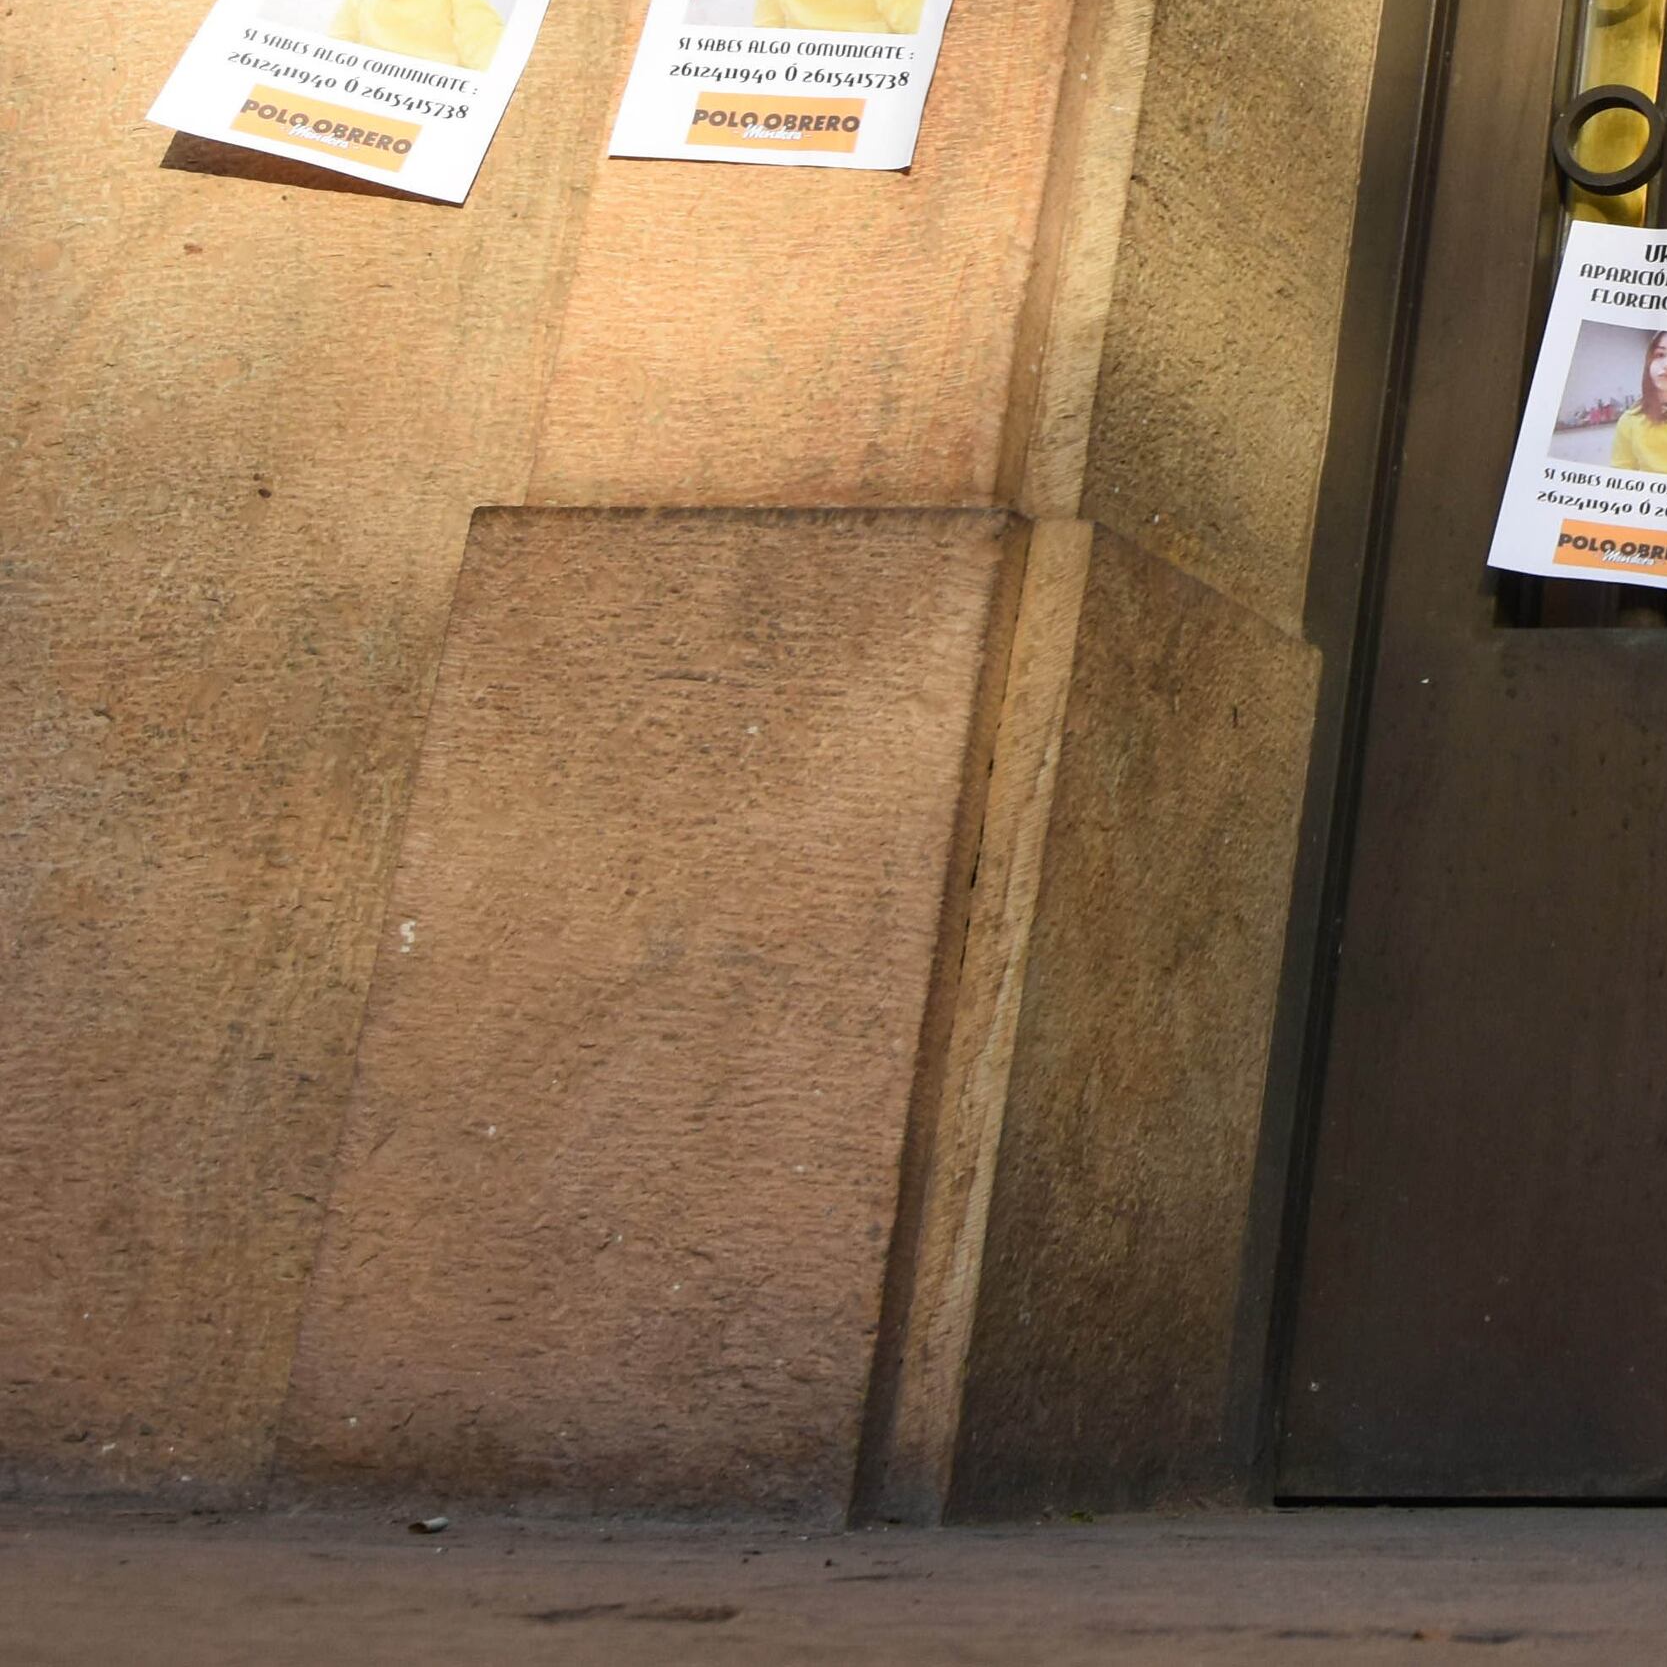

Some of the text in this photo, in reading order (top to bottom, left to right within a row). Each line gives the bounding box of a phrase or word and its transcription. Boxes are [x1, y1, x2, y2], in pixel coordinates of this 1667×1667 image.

[679, 37, 690, 50] SI
[698, 38, 742, 53] SABES
[748, 41, 790, 54] ALGO
[692, 109, 860, 133] POLO OBRERO
[1558, 533, 1616, 553] POLO
